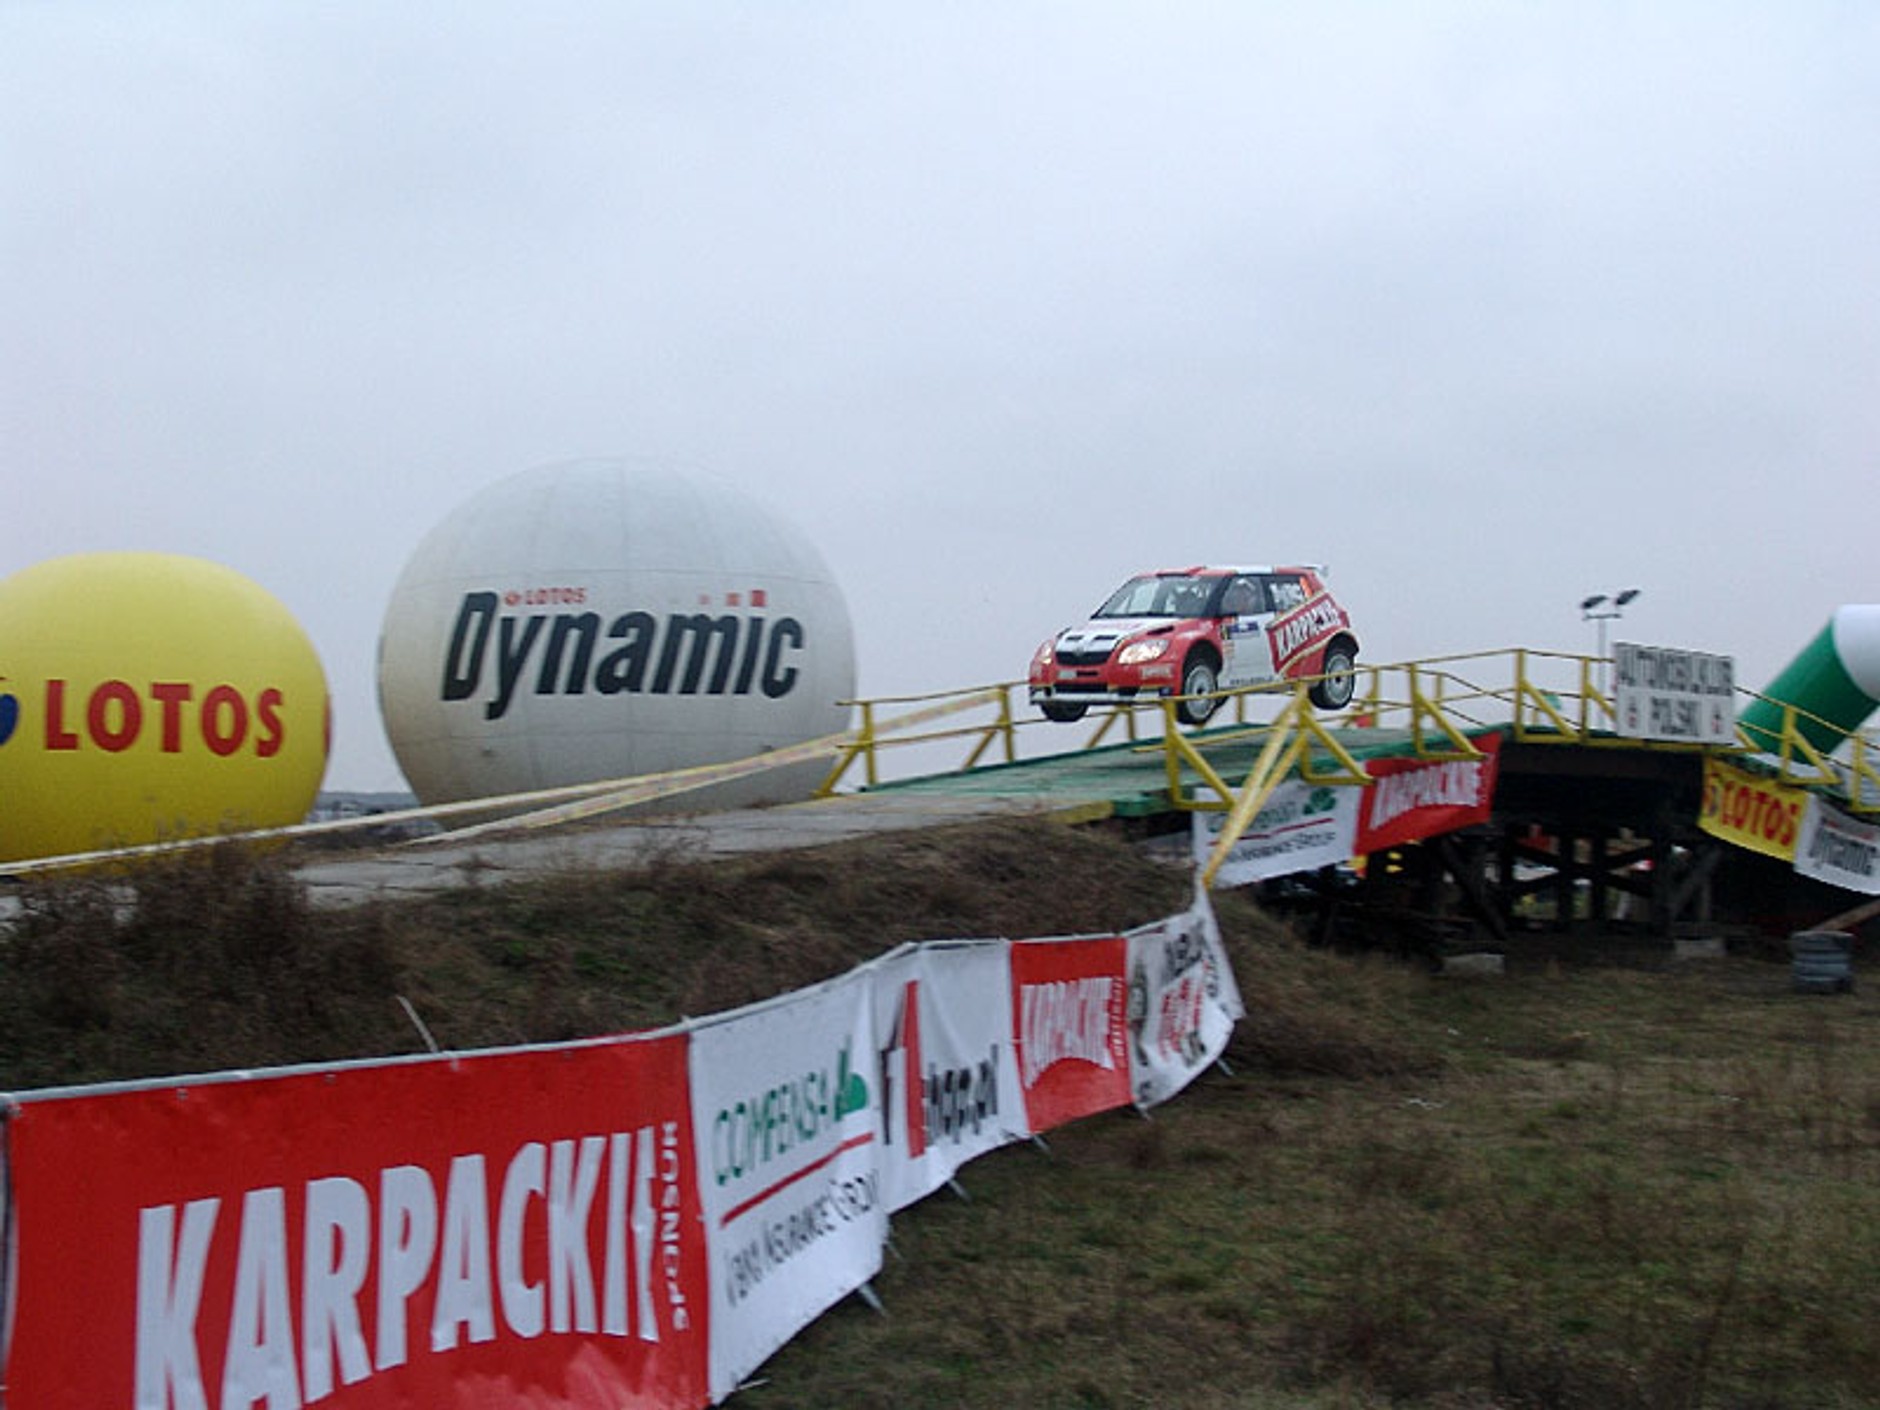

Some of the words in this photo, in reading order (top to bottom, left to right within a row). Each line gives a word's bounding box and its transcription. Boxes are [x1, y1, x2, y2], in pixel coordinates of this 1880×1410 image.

[442, 590, 804, 720] Dynamic
[45, 679, 284, 758] LOTOS
[1720, 780, 1800, 847] LOTOS
